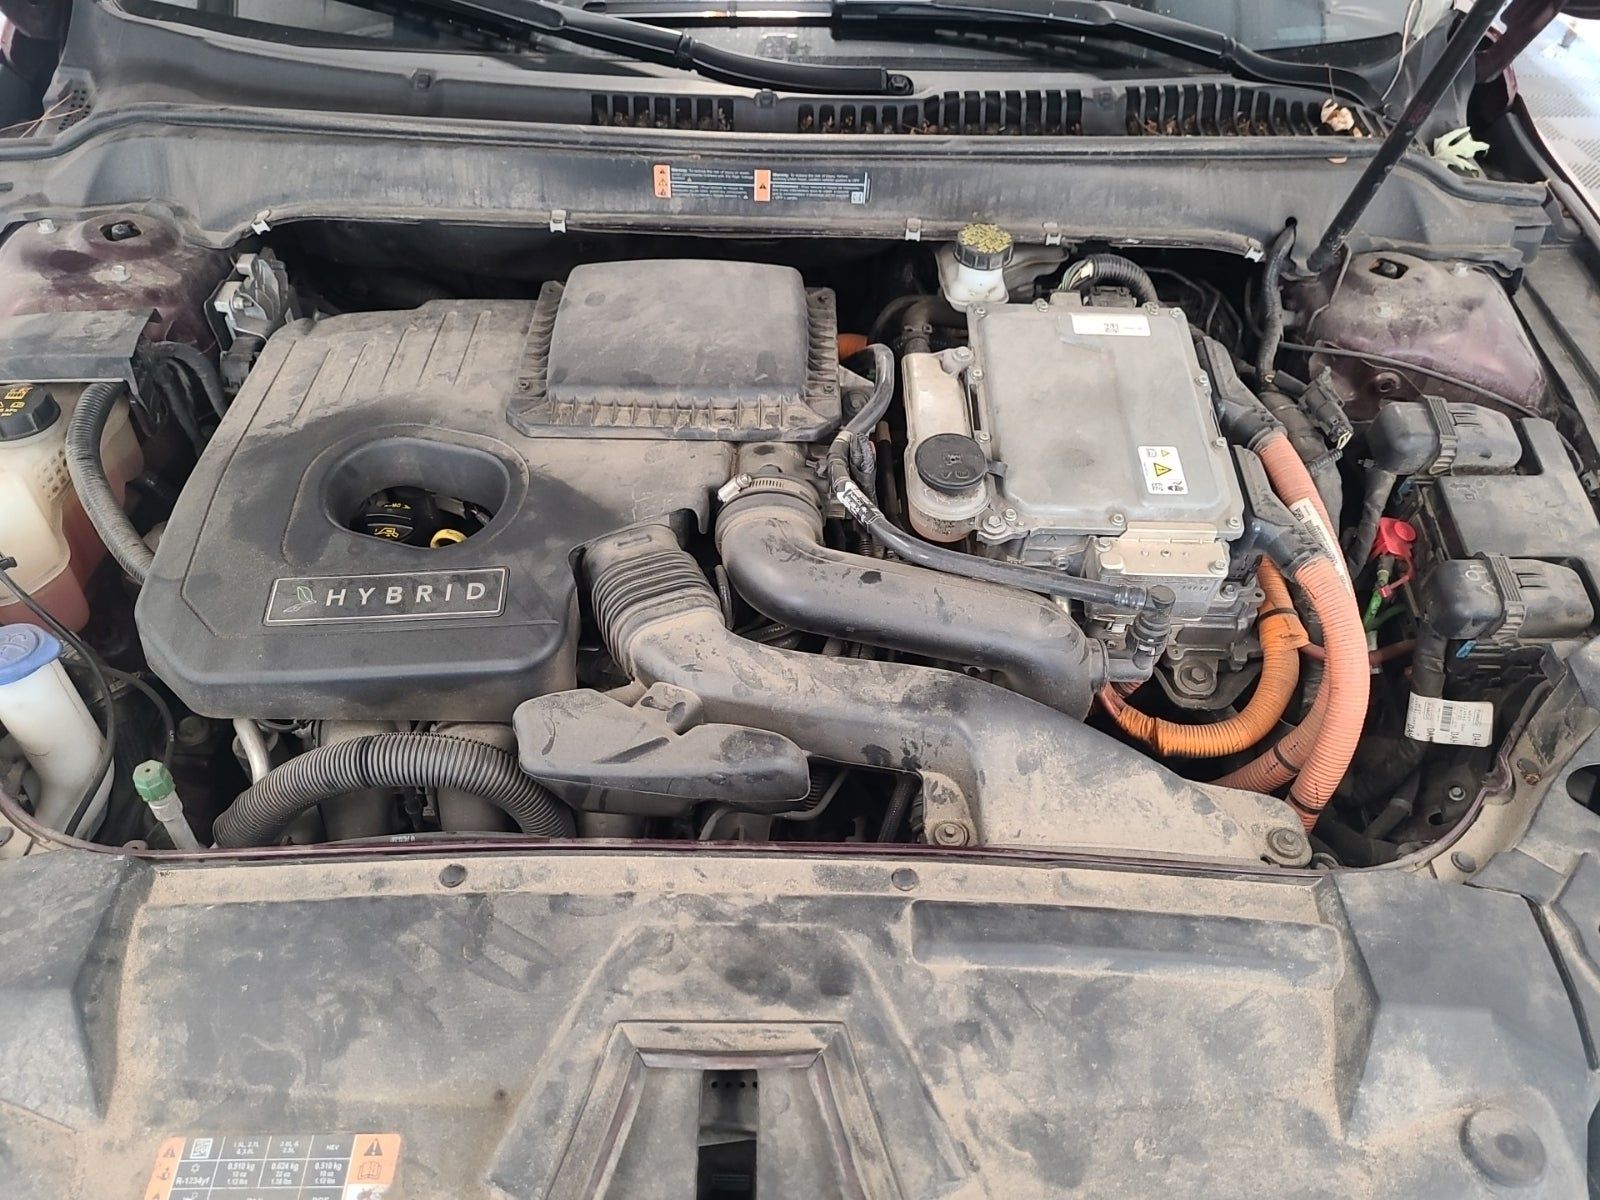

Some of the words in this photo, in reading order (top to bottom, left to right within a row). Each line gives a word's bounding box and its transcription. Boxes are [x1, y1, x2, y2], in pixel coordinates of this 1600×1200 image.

[325, 582, 486, 606] HYBRID
[245, 1162, 256, 1172] kg
[289, 1162, 300, 1172] kg
[314, 1161, 333, 1170] 0.510
[333, 1161, 343, 1172] kg
[175, 1176, 210, 1186] R-1234yf
[239, 1177, 248, 1185] lbs
[326, 1176, 336, 1184] lbs
